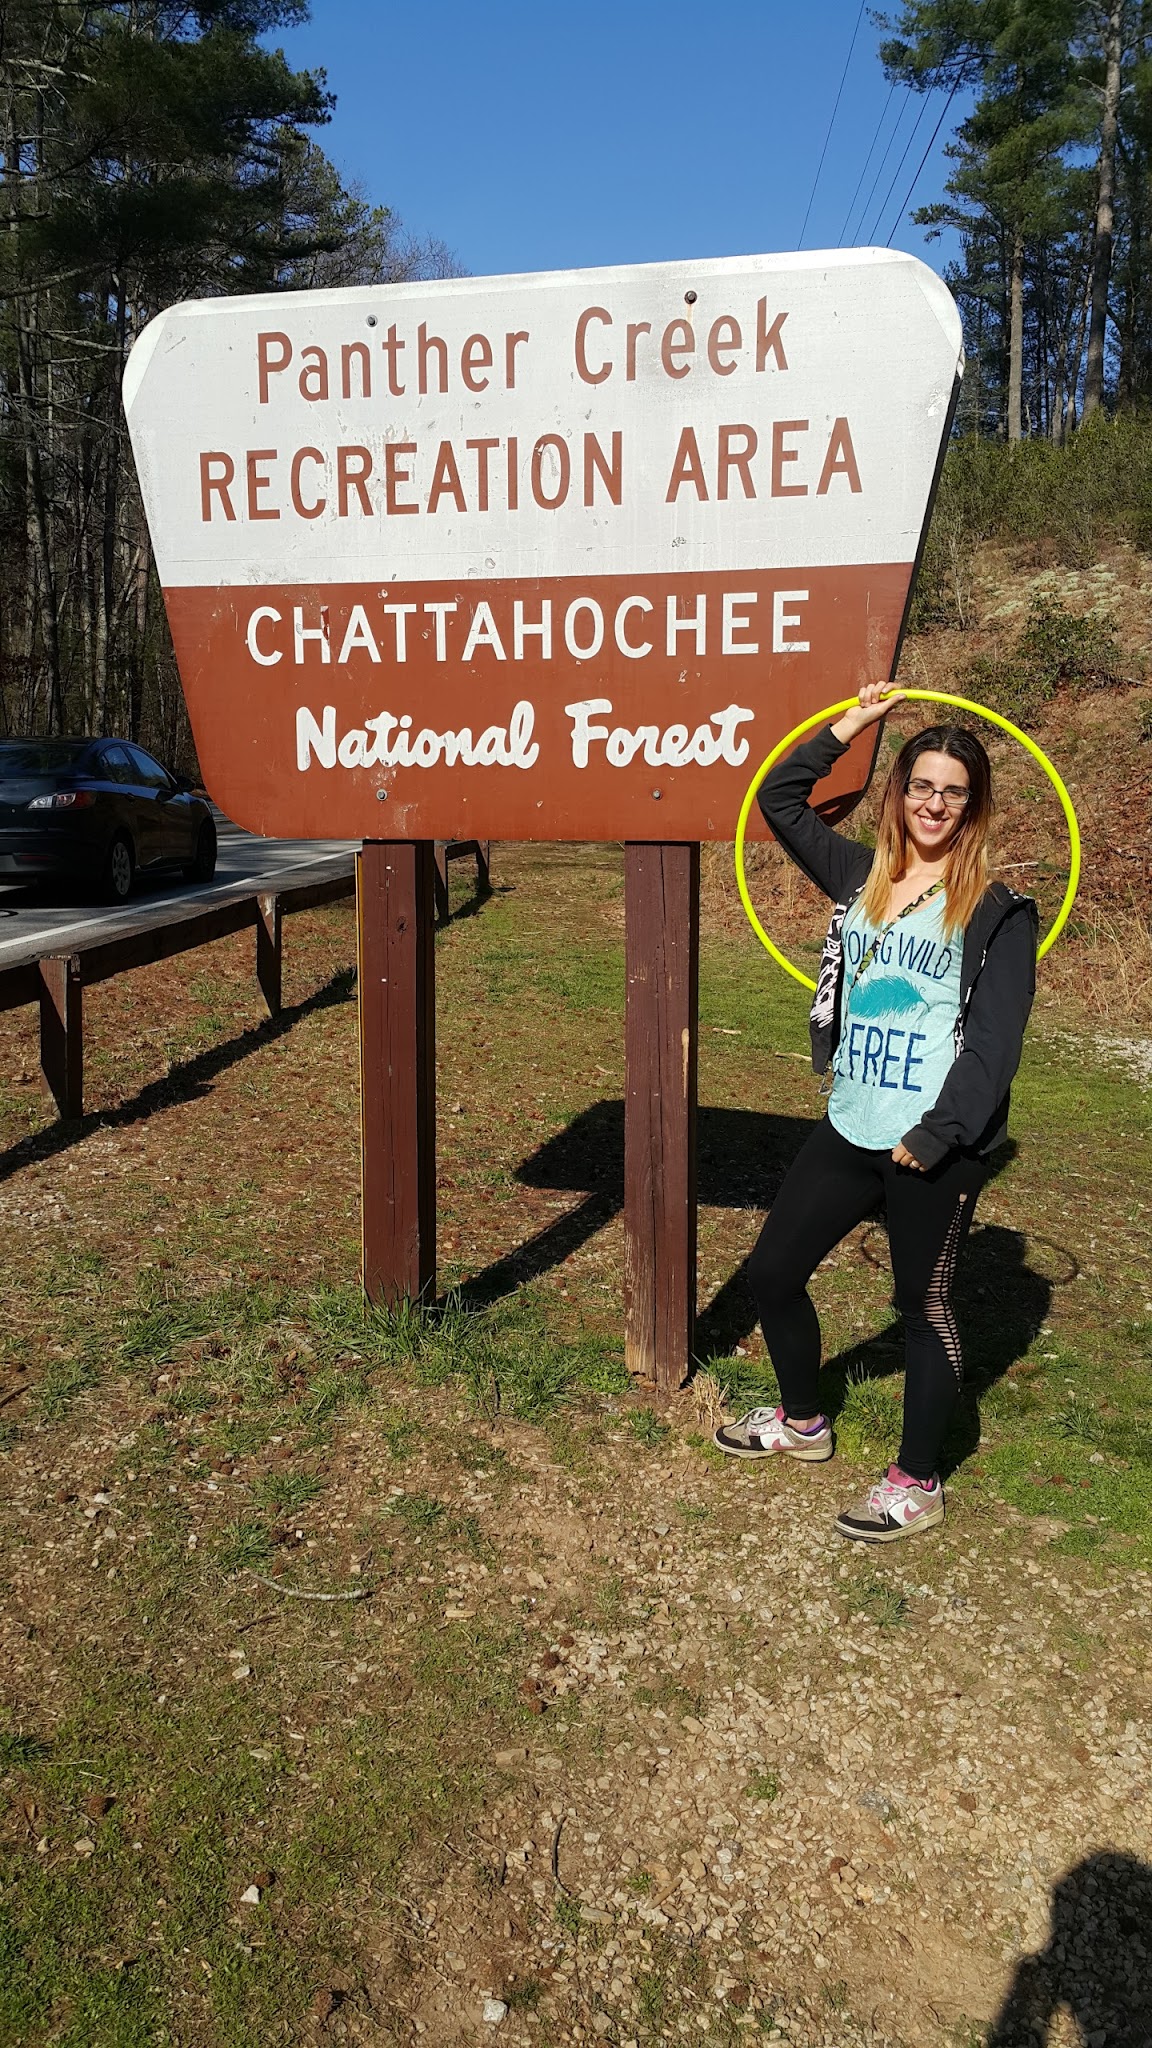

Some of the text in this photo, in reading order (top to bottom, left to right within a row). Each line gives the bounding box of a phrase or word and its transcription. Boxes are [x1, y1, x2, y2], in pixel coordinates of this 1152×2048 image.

[258, 295, 789, 404] Panther Creek
[200, 416, 863, 522] RECREATION AREA
[246, 589, 811, 666] CHATTAHOCHEE
[296, 698, 755, 772] National Forest
[899, 932, 952, 979] WILD
[849, 1023, 926, 1092] FREE
